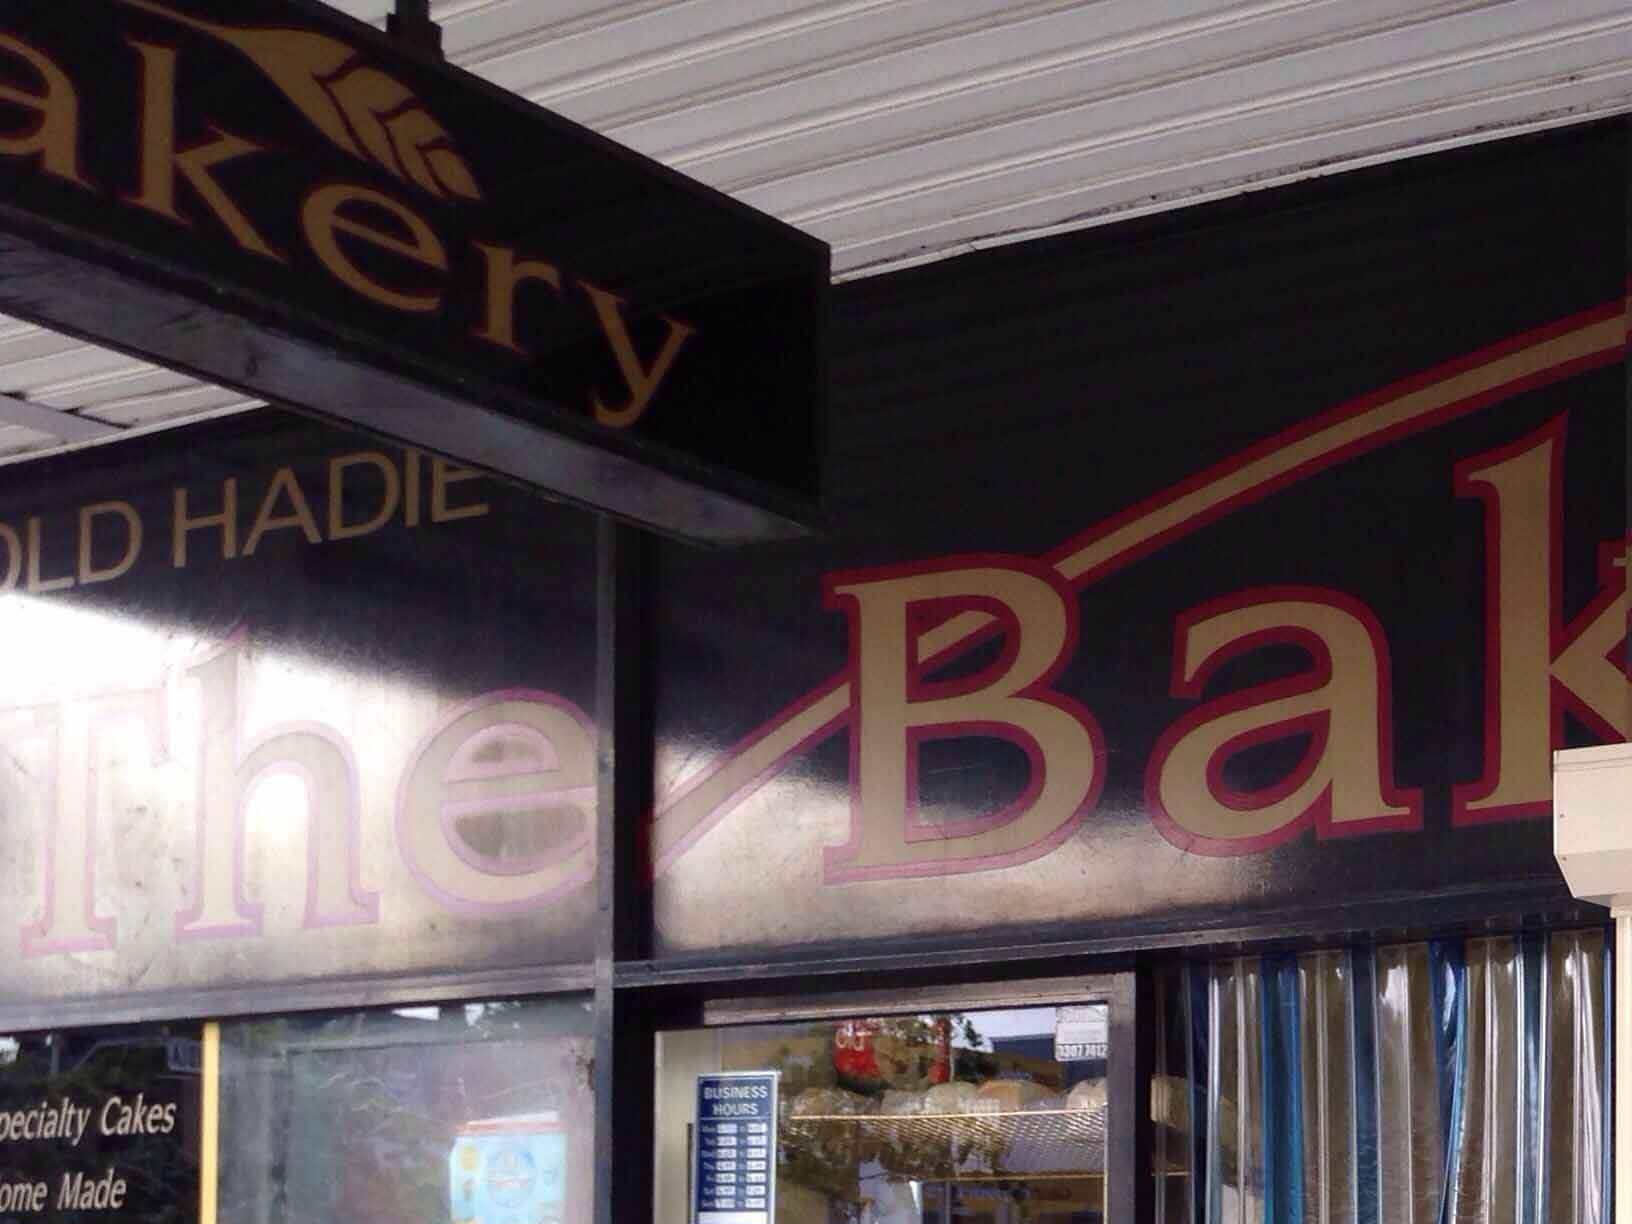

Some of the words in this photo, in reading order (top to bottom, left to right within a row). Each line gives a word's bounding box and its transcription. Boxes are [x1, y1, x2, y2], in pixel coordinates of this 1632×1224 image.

[0, 28, 698, 429] akery
[0, 622, 598, 957] The
[101, 1093, 177, 1136] Cakes
[704, 1086, 768, 1100] BUSINESS
[712, 1103, 759, 1116] HOURS
[0, 1180, 48, 1213] ome
[56, 1168, 128, 1210] Made
